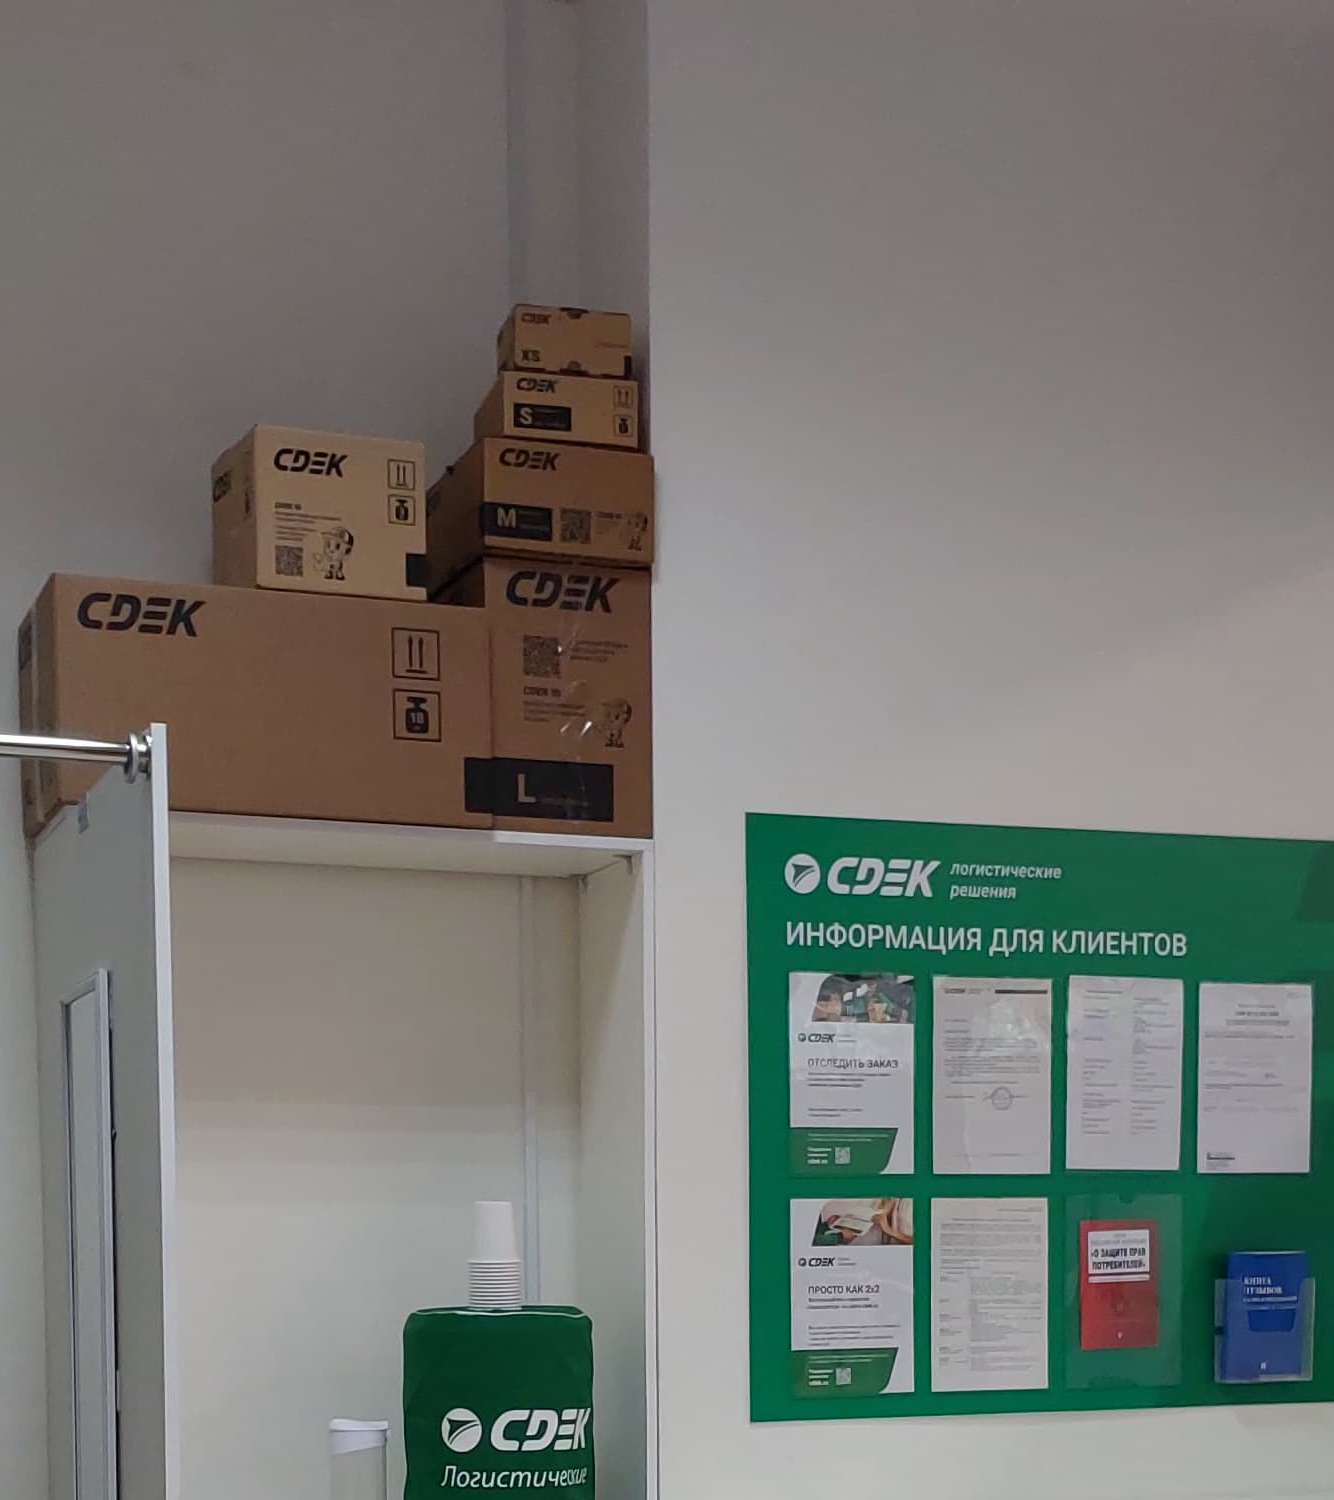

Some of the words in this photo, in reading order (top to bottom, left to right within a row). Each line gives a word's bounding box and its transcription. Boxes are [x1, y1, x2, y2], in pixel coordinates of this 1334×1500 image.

[521, 349, 540, 362] XS
[517, 378, 558, 393] CDEK
[519, 407, 533, 424] S
[274, 448, 348, 477] CDEK
[499, 448, 561, 471] CDEK
[497, 507, 516, 528] M
[506, 571, 621, 613] CDEK
[77, 592, 207, 637] CDEK
[517, 773, 537, 803] L
[827, 857, 941, 898] CDEK
[950, 862, 1062, 879] логистические
[950, 885, 1016, 900] решения
[786, 921, 982, 955] ИНФОРМАЦИЯ
[989, 928, 1044, 957] ДЛЯ
[1052, 930, 1187, 956] КЛИЕНТОВ
[808, 1033, 835, 1043] CDEK
[808, 1058, 865, 1070] ОТСЛЕДИТЬ
[867, 1059, 898, 1069] ЗАКАЗ
[808, 1257, 835, 1267] CDEK
[808, 1285, 844, 1295] ПРОСТО
[846, 1285, 863, 1294] КАК
[490, 1408, 591, 1451] CDEK
[441, 1465, 587, 1488] Логистические
